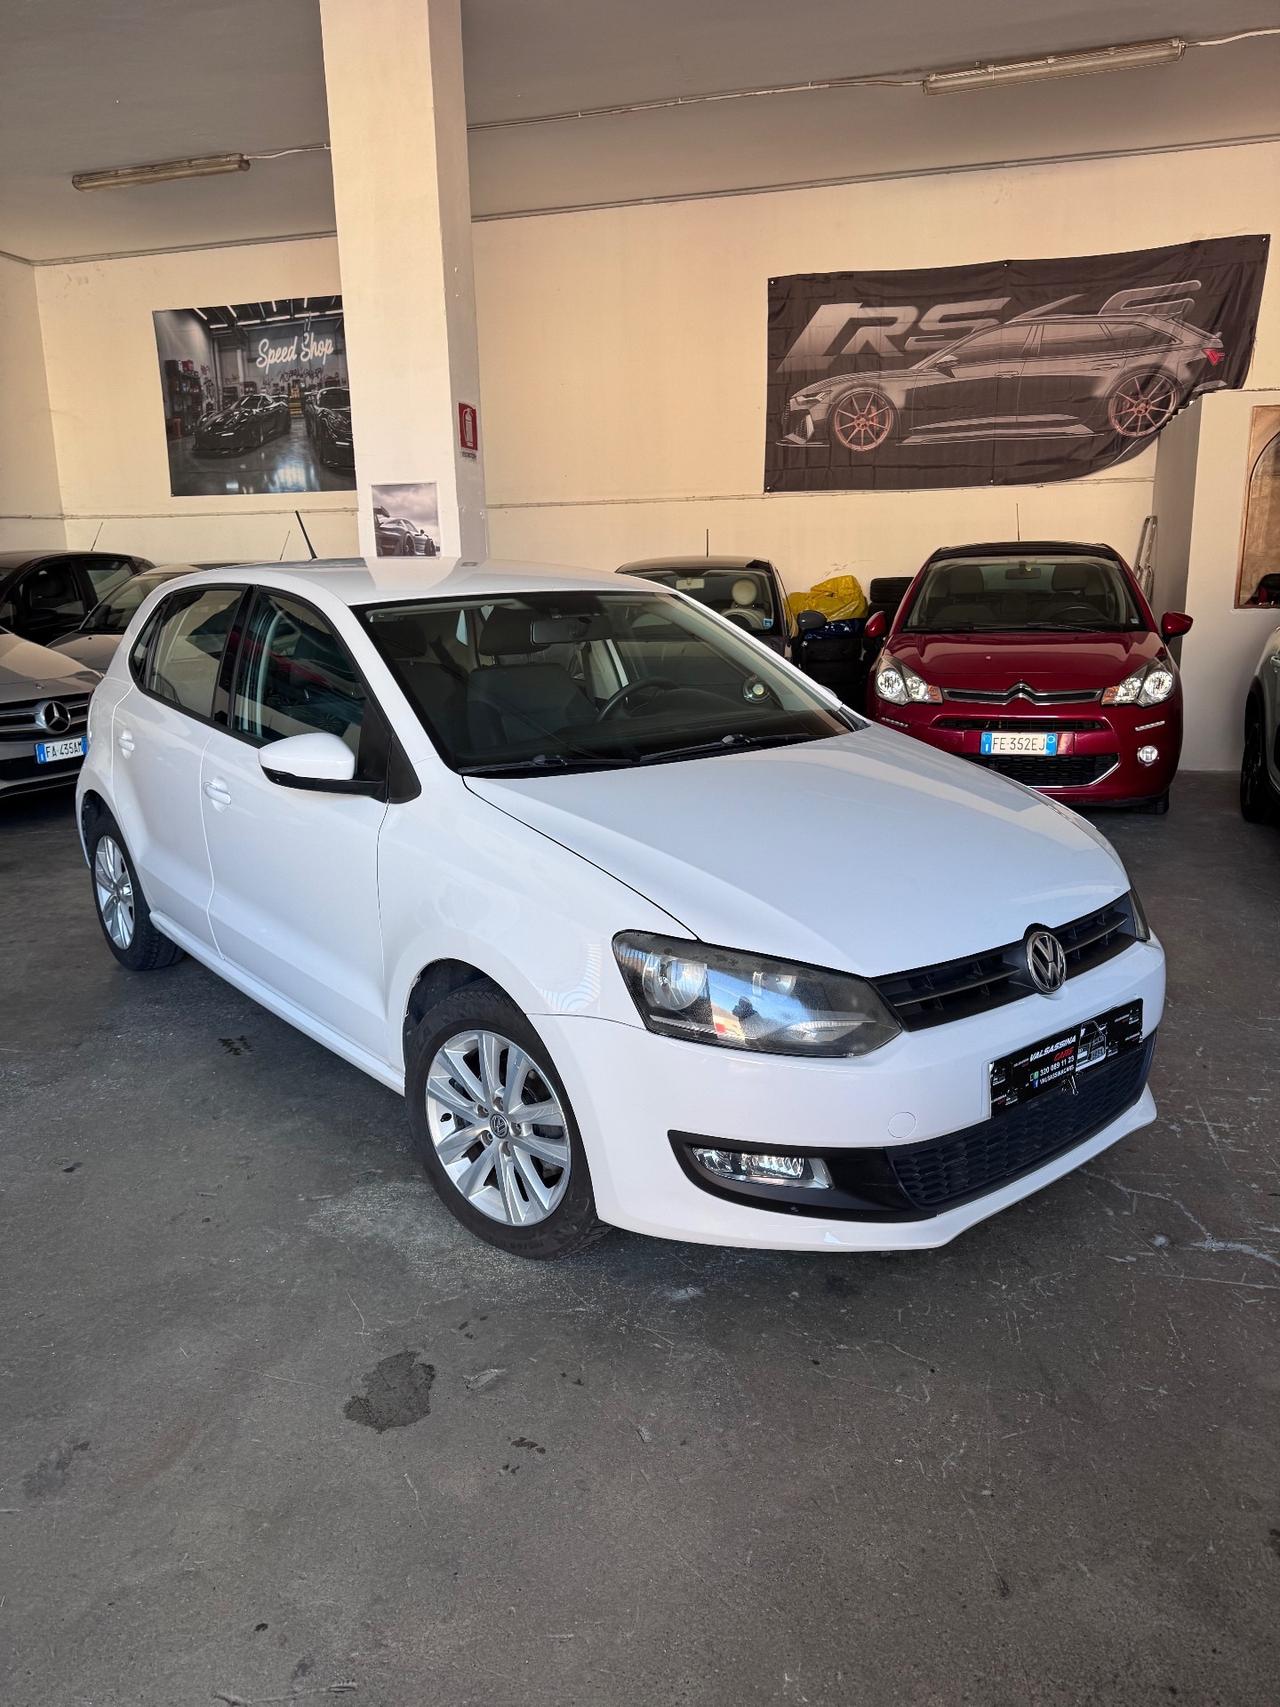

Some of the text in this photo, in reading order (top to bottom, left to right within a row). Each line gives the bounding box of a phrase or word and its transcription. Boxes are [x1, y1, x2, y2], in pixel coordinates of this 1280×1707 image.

[256, 331, 334, 374] Speed Shop
[1029, 1034, 1077, 1062] VALSASSINA
